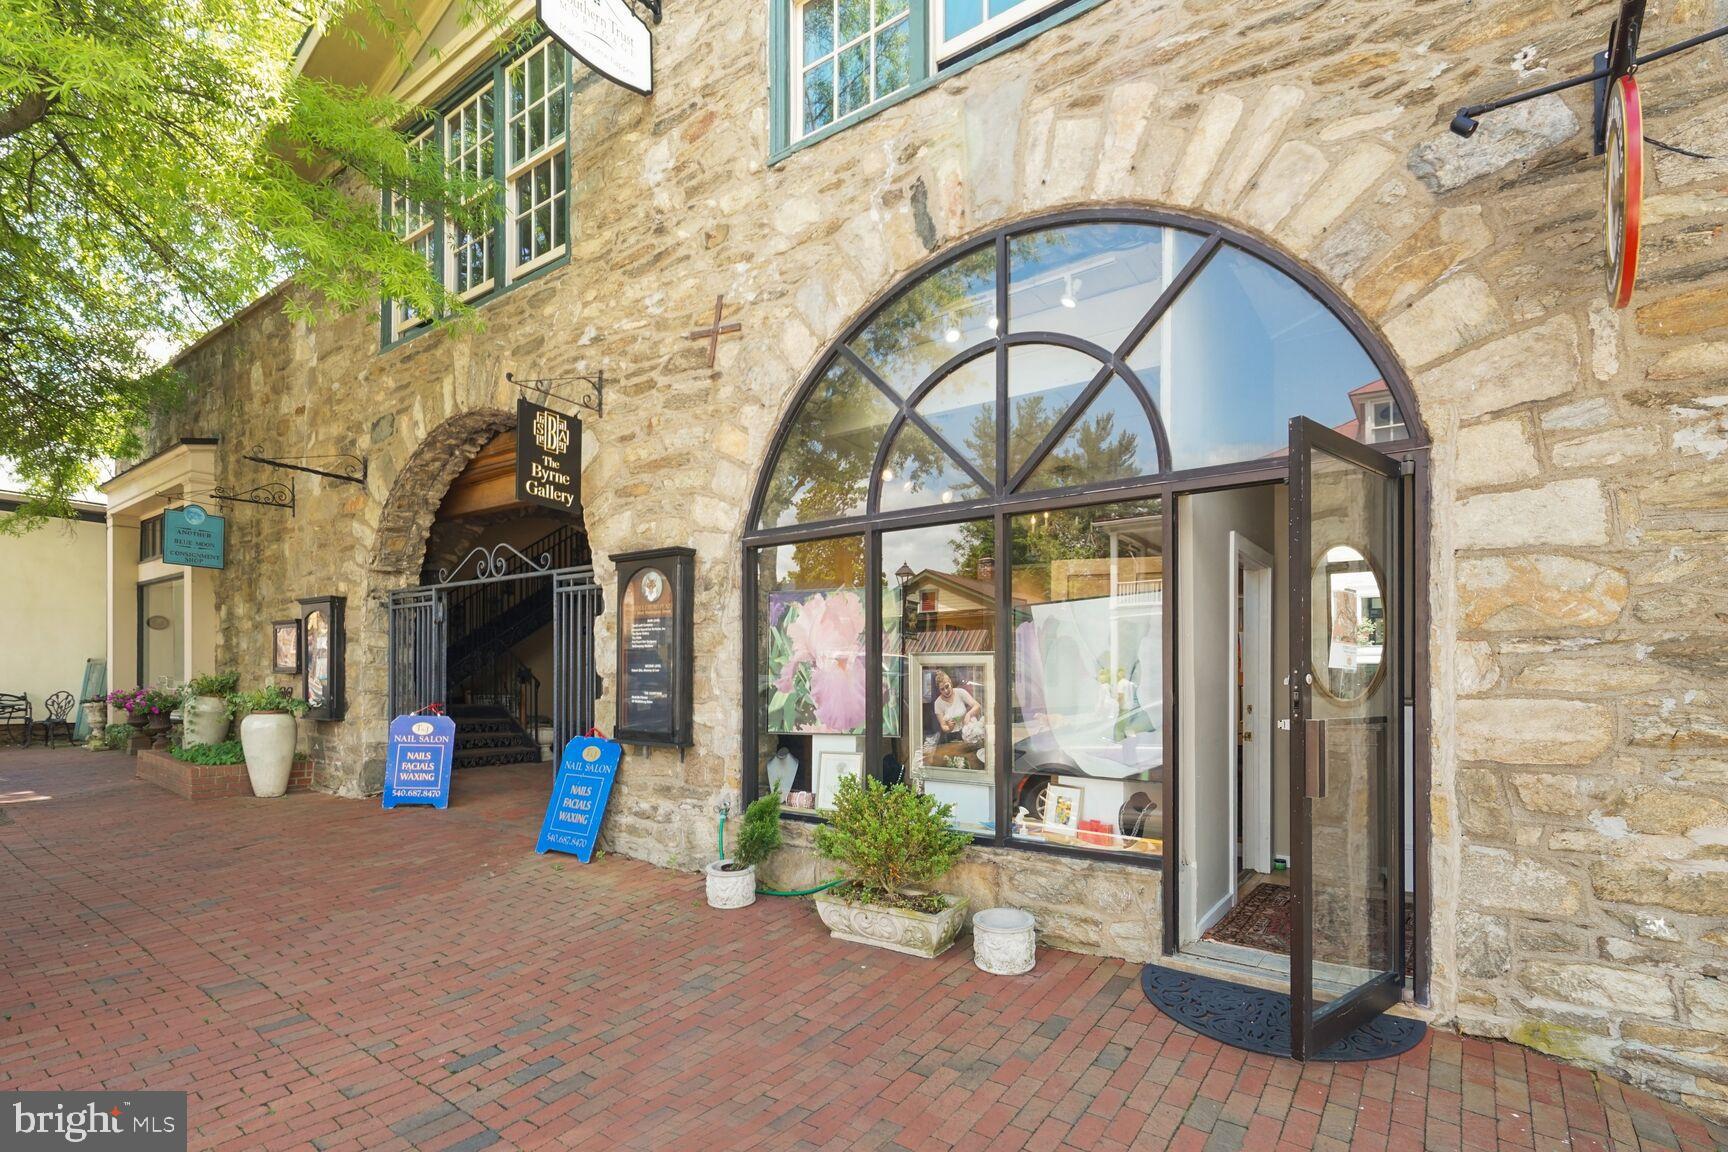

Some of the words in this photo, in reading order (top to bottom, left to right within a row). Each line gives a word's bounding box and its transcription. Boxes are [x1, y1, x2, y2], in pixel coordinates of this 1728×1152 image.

[567, 0, 607, 29] outhern
[608, 19, 635, 48] Trust
[542, 455, 561, 469] The
[531, 462, 570, 485] Byrne
[525, 480, 574, 507] Gallery
[176, 529, 212, 539] ANOTHER
[170, 550, 220, 561] CONSIGNMENT
[394, 735, 416, 743] NAIL
[419, 735, 450, 743] SALON
[406, 751, 432, 760] NAILS
[401, 761, 435, 771] FACIALS
[564, 760, 583, 772] NAIL
[584, 763, 612, 774] SALON
[400, 772, 435, 781] WAXING
[392, 789, 441, 797] 540.687.8470
[570, 784, 592, 797] NAILS
[562, 797, 592, 811] FACIALS
[559, 811, 589, 825] WAXING
